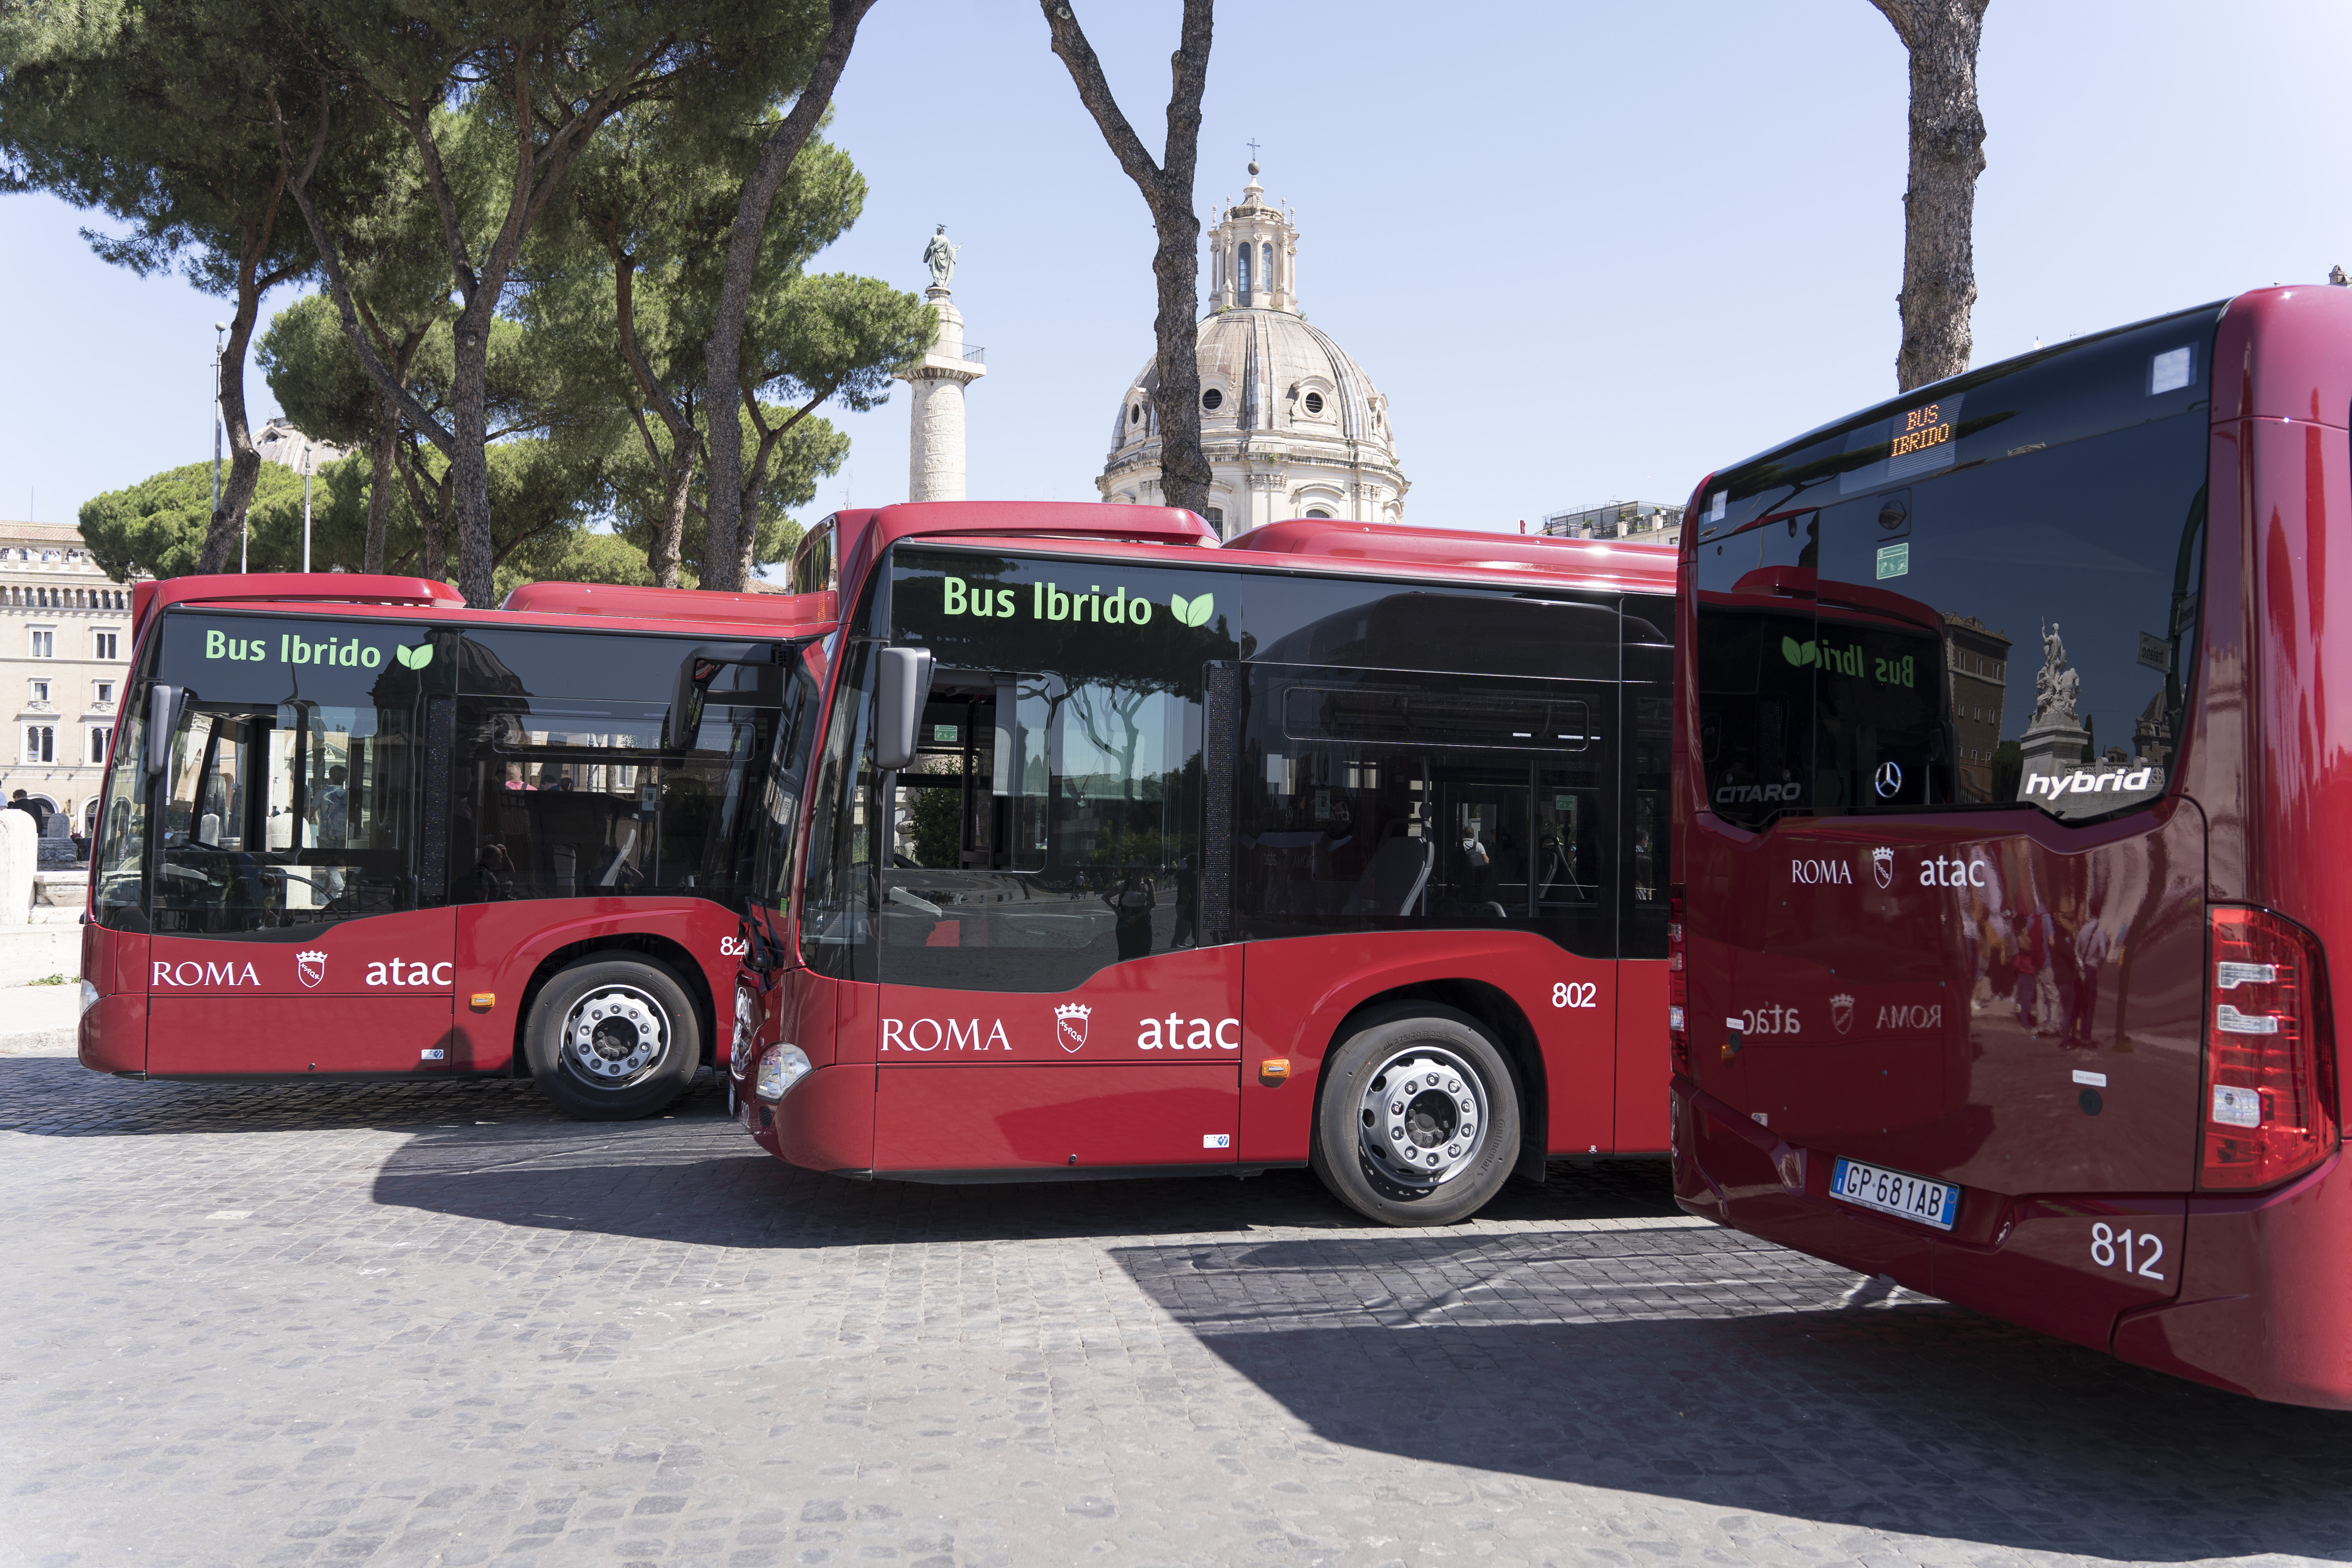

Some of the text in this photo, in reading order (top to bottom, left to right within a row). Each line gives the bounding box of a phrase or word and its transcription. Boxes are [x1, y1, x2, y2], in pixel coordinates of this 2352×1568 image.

[1906, 405, 1939, 431] BUS
[1891, 423, 1949, 457] IBRIDO
[944, 577, 1151, 625] Bus Ibrido
[206, 630, 380, 667] Bus Ibrido
[1715, 782, 1801, 803] CITARO
[2025, 768, 2151, 800] hybrid
[1792, 860, 1852, 884] ROMA
[1920, 856, 1985, 887] atac
[152, 962, 261, 986] ROMA
[366, 958, 452, 985] atac
[1552, 983, 1596, 1007] 802
[881, 1019, 1012, 1051] ROMA
[1063, 1023, 1083, 1042] SPQR
[1138, 1012, 1239, 1050] atac
[1481, 1119, 1506, 1173] Continental
[2091, 1223, 2163, 1280] 812
